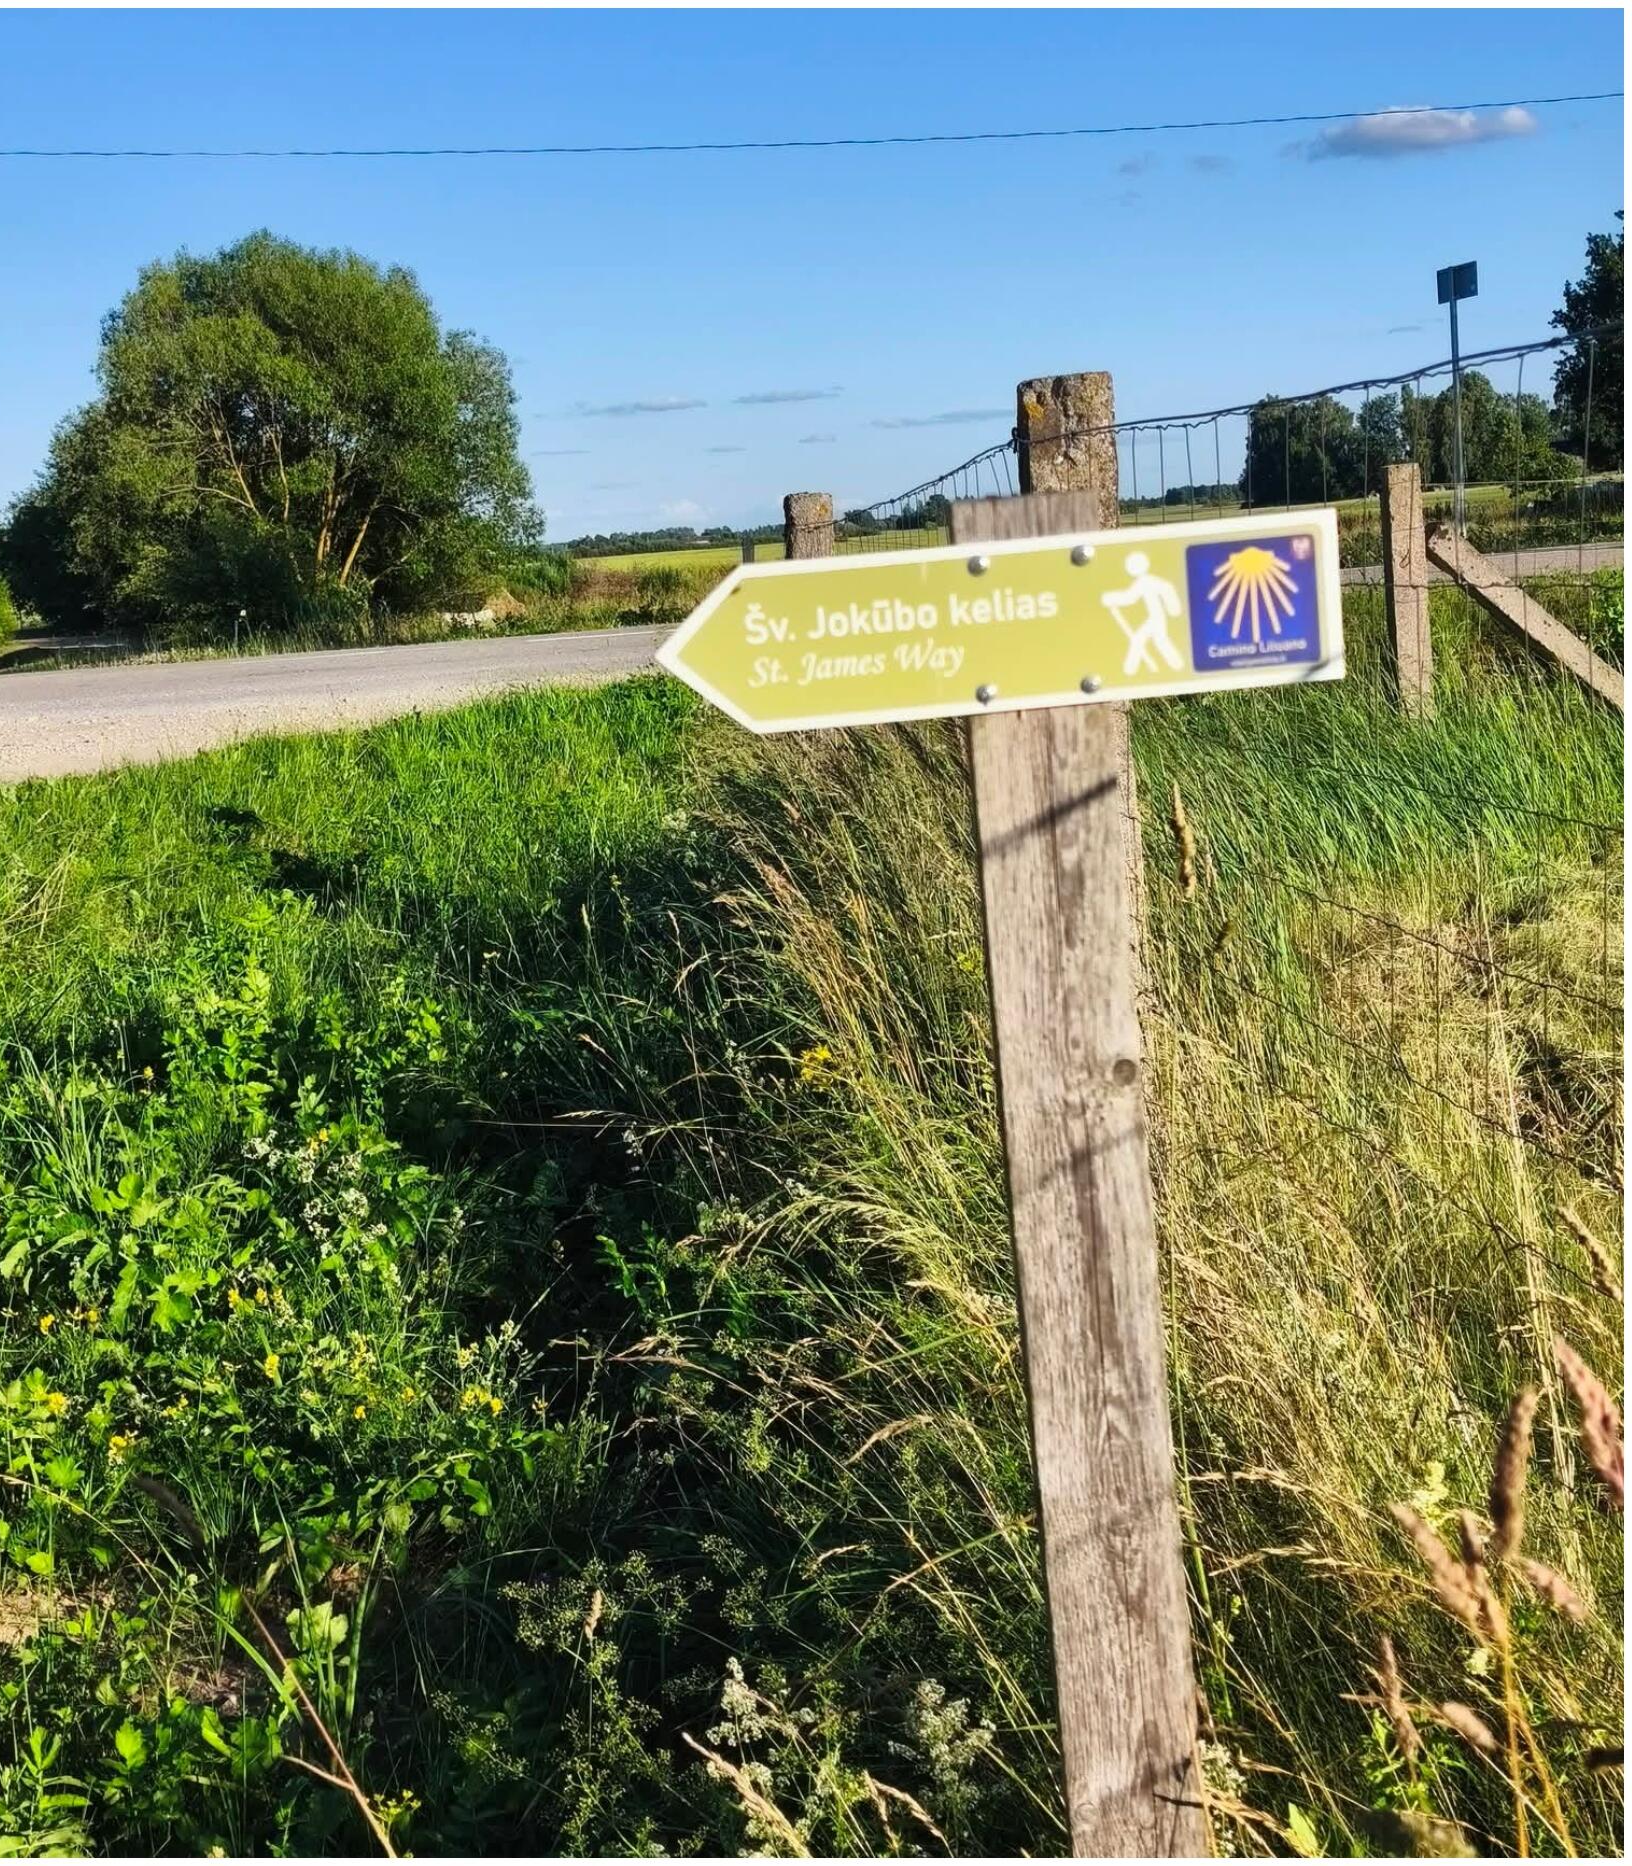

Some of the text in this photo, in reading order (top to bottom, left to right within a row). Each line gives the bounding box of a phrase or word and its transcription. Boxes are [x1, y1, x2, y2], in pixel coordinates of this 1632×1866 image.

[743, 586, 1059, 645] Šv. Jokūbo kelias
[747, 637, 966, 688] St. James Way
[1207, 643, 1258, 659] Camino
